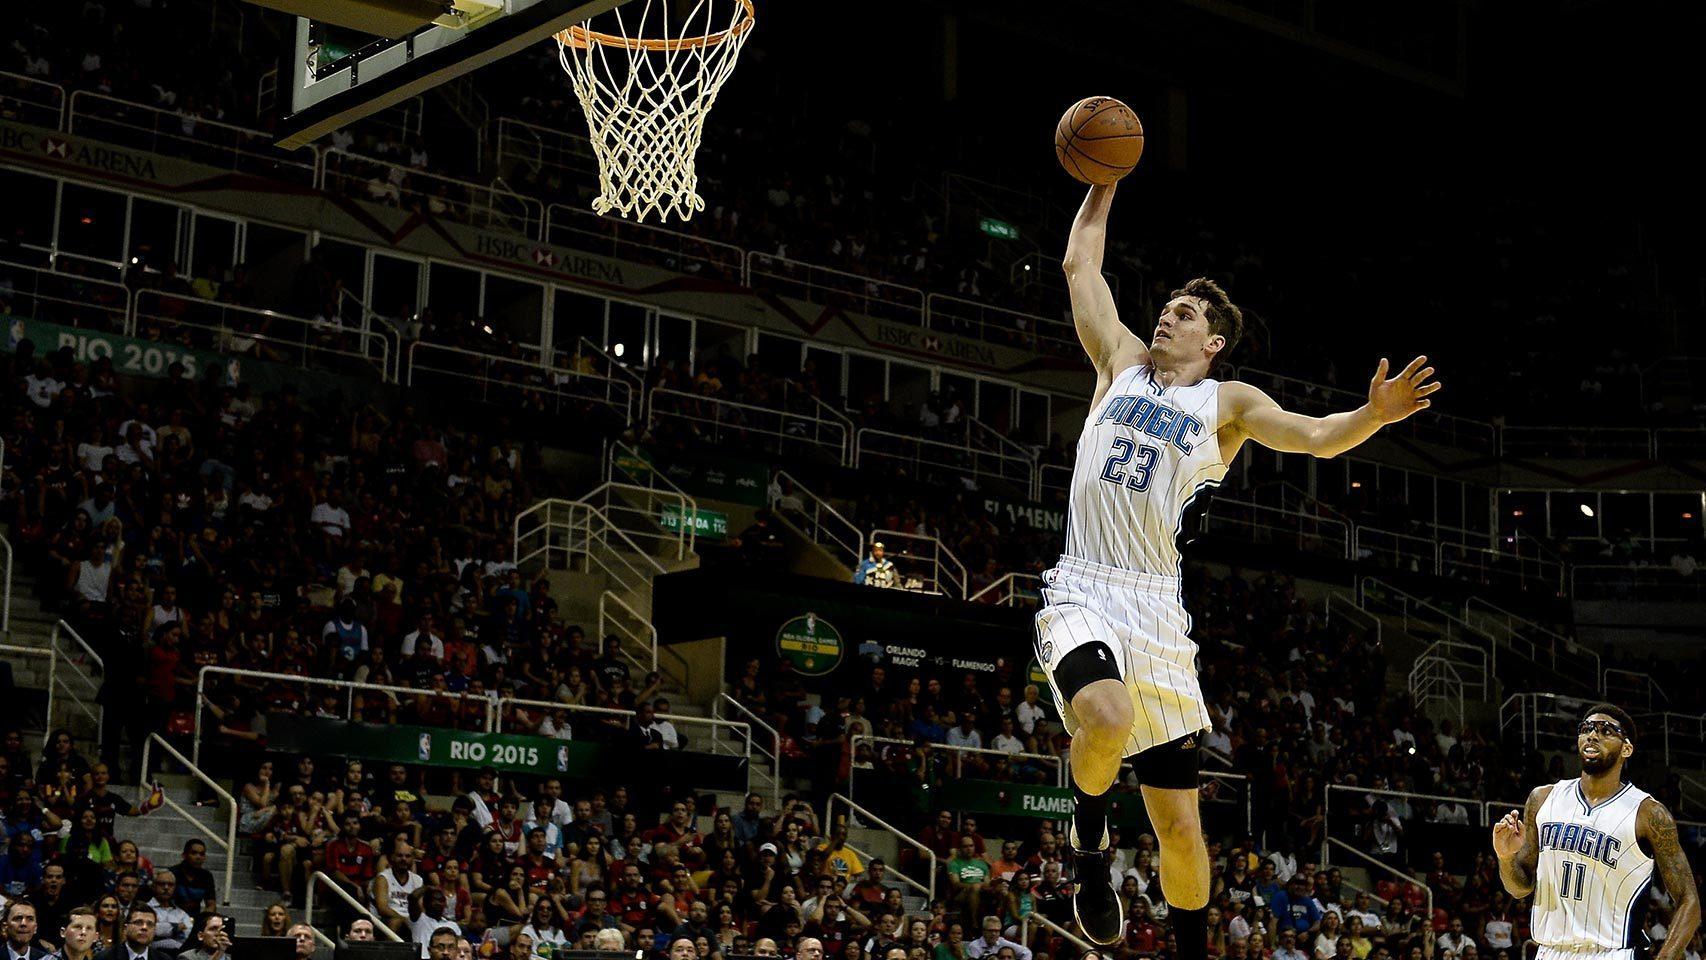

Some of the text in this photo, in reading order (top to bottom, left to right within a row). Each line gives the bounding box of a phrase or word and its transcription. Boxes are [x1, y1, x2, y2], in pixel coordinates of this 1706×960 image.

[77, 145, 156, 178] ARENA
[478, 235, 624, 284] HSBC ARENA
[58, 332, 114, 362] RIO
[1095, 395, 1203, 456] MAGIC
[1100, 436, 1160, 493] 23
[983, 498, 1065, 532] FLAMEN
[886, 645, 926, 658] ORLANDO
[892, 656, 920, 669] MAGIC
[951, 658, 996, 673] FLAMENGO
[450, 740, 539, 767] RIO 2015
[1539, 821, 1621, 870] MAGIC
[1560, 860, 1586, 901] 11
